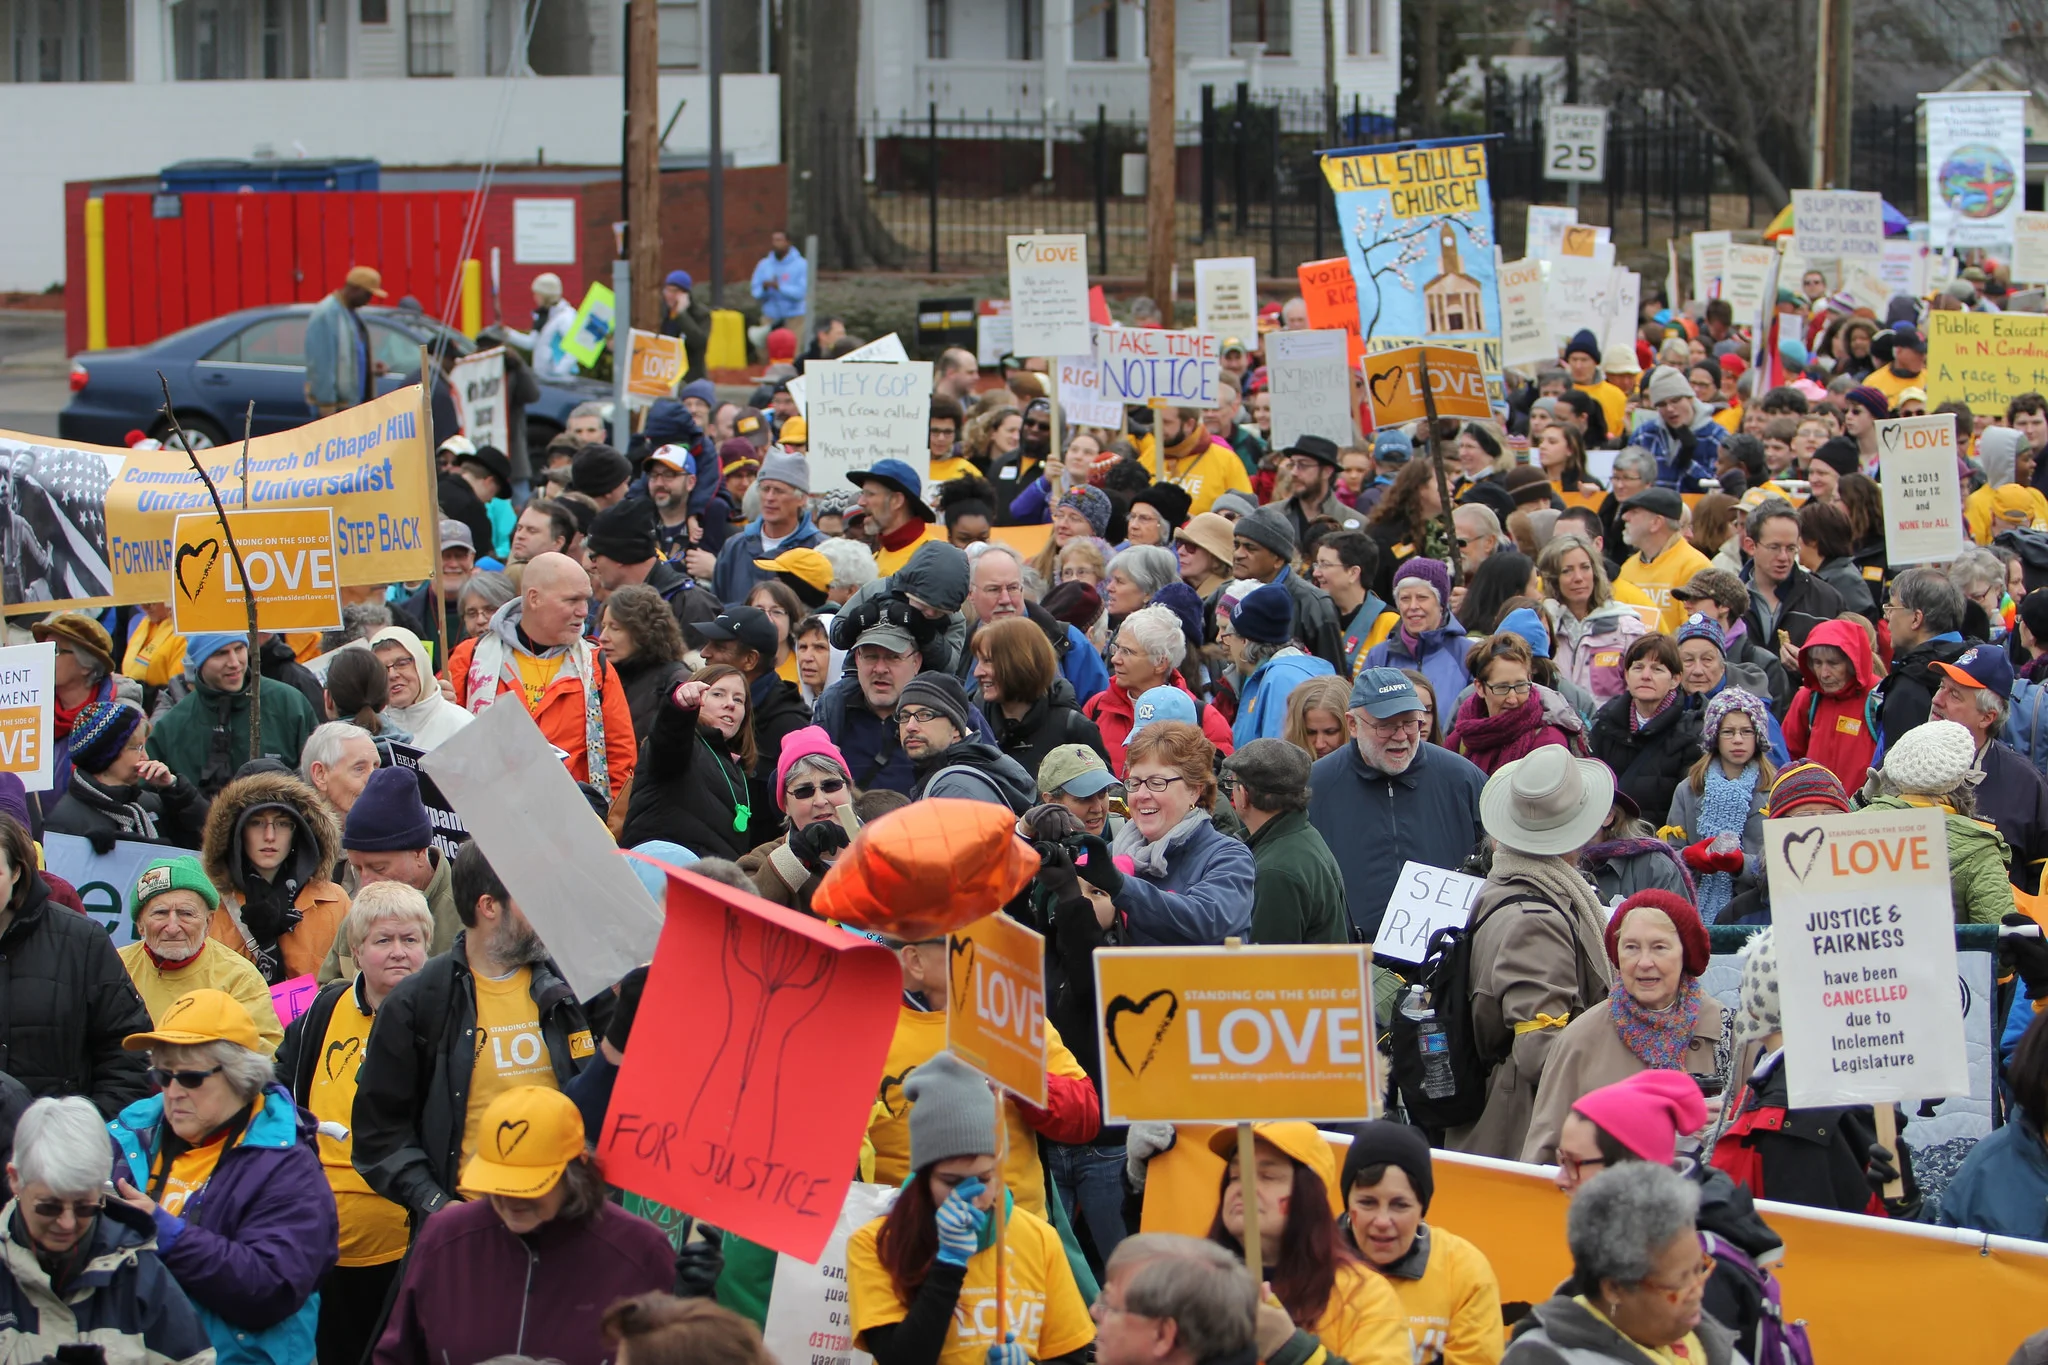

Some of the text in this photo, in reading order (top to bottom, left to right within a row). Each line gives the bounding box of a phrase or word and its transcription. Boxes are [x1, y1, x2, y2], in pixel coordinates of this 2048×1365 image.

[1554, 113, 1599, 127] SPEED
[1557, 129, 1595, 140] LIMIT
[1342, 145, 1482, 187] ALL SOULS
[1553, 144, 1596, 171] 25
[1392, 179, 1479, 215] CHURCH
[1035, 246, 1078, 263] LOVE
[1504, 268, 1538, 287] LOVE
[1935, 314, 1980, 336] Public
[1103, 329, 1159, 355] TAKE
[1955, 343, 1969, 356] in
[643, 354, 675, 380] LOVE
[1939, 363, 1953, 381] A
[1962, 369, 1996, 383] race
[2006, 366, 2020, 384] to
[820, 371, 918, 397] HEY GOP
[1406, 369, 1485, 397] LOVE
[816, 401, 920, 420] Jim Crow called
[864, 423, 892, 439] said
[1904, 428, 1950, 449] LOVE
[233, 453, 298, 476] Church
[303, 444, 321, 467] of
[324, 430, 382, 465] Chapel
[385, 411, 416, 441] Hill
[251, 457, 395, 503] Universalist
[1918, 472, 1939, 483] 2013
[1903, 487, 1940, 498] All for 1%
[1916, 501, 1930, 511] and
[337, 515, 375, 556] STEP
[378, 513, 423, 552] BACK
[1899, 518, 1949, 530] NONE for ALL
[265, 537, 278, 545] ON
[280, 536, 296, 545] THE
[297, 535, 316, 544] SIDE
[318, 535, 330, 543] OF
[223, 549, 333, 592] LOVE
[3, 718, 13, 726] THE
[395, 753, 417, 769] HELP
[1828, 829, 1866, 838] STANDING
[1830, 836, 1930, 876] LOVE
[1805, 904, 1902, 931] JUSTICE &
[1813, 928, 1904, 955] FAIRNESS
[1824, 966, 1897, 985] have been
[976, 961, 1044, 1048] LOVE
[1184, 988, 1359, 1001] STANDING ON THE SIDE OF
[1823, 984, 1908, 1007] CANCELLED
[490, 1023, 527, 1033] STANDING
[1846, 1010, 1891, 1027] due to
[1186, 1007, 1362, 1066] LOVE
[1832, 1030, 1905, 1051] Inclement
[492, 1030, 549, 1068] LO
[1832, 1054, 1914, 1074] Legislature
[608, 1113, 831, 1217] FOR JUSTICE
[954, 1297, 1045, 1340] LOVE
